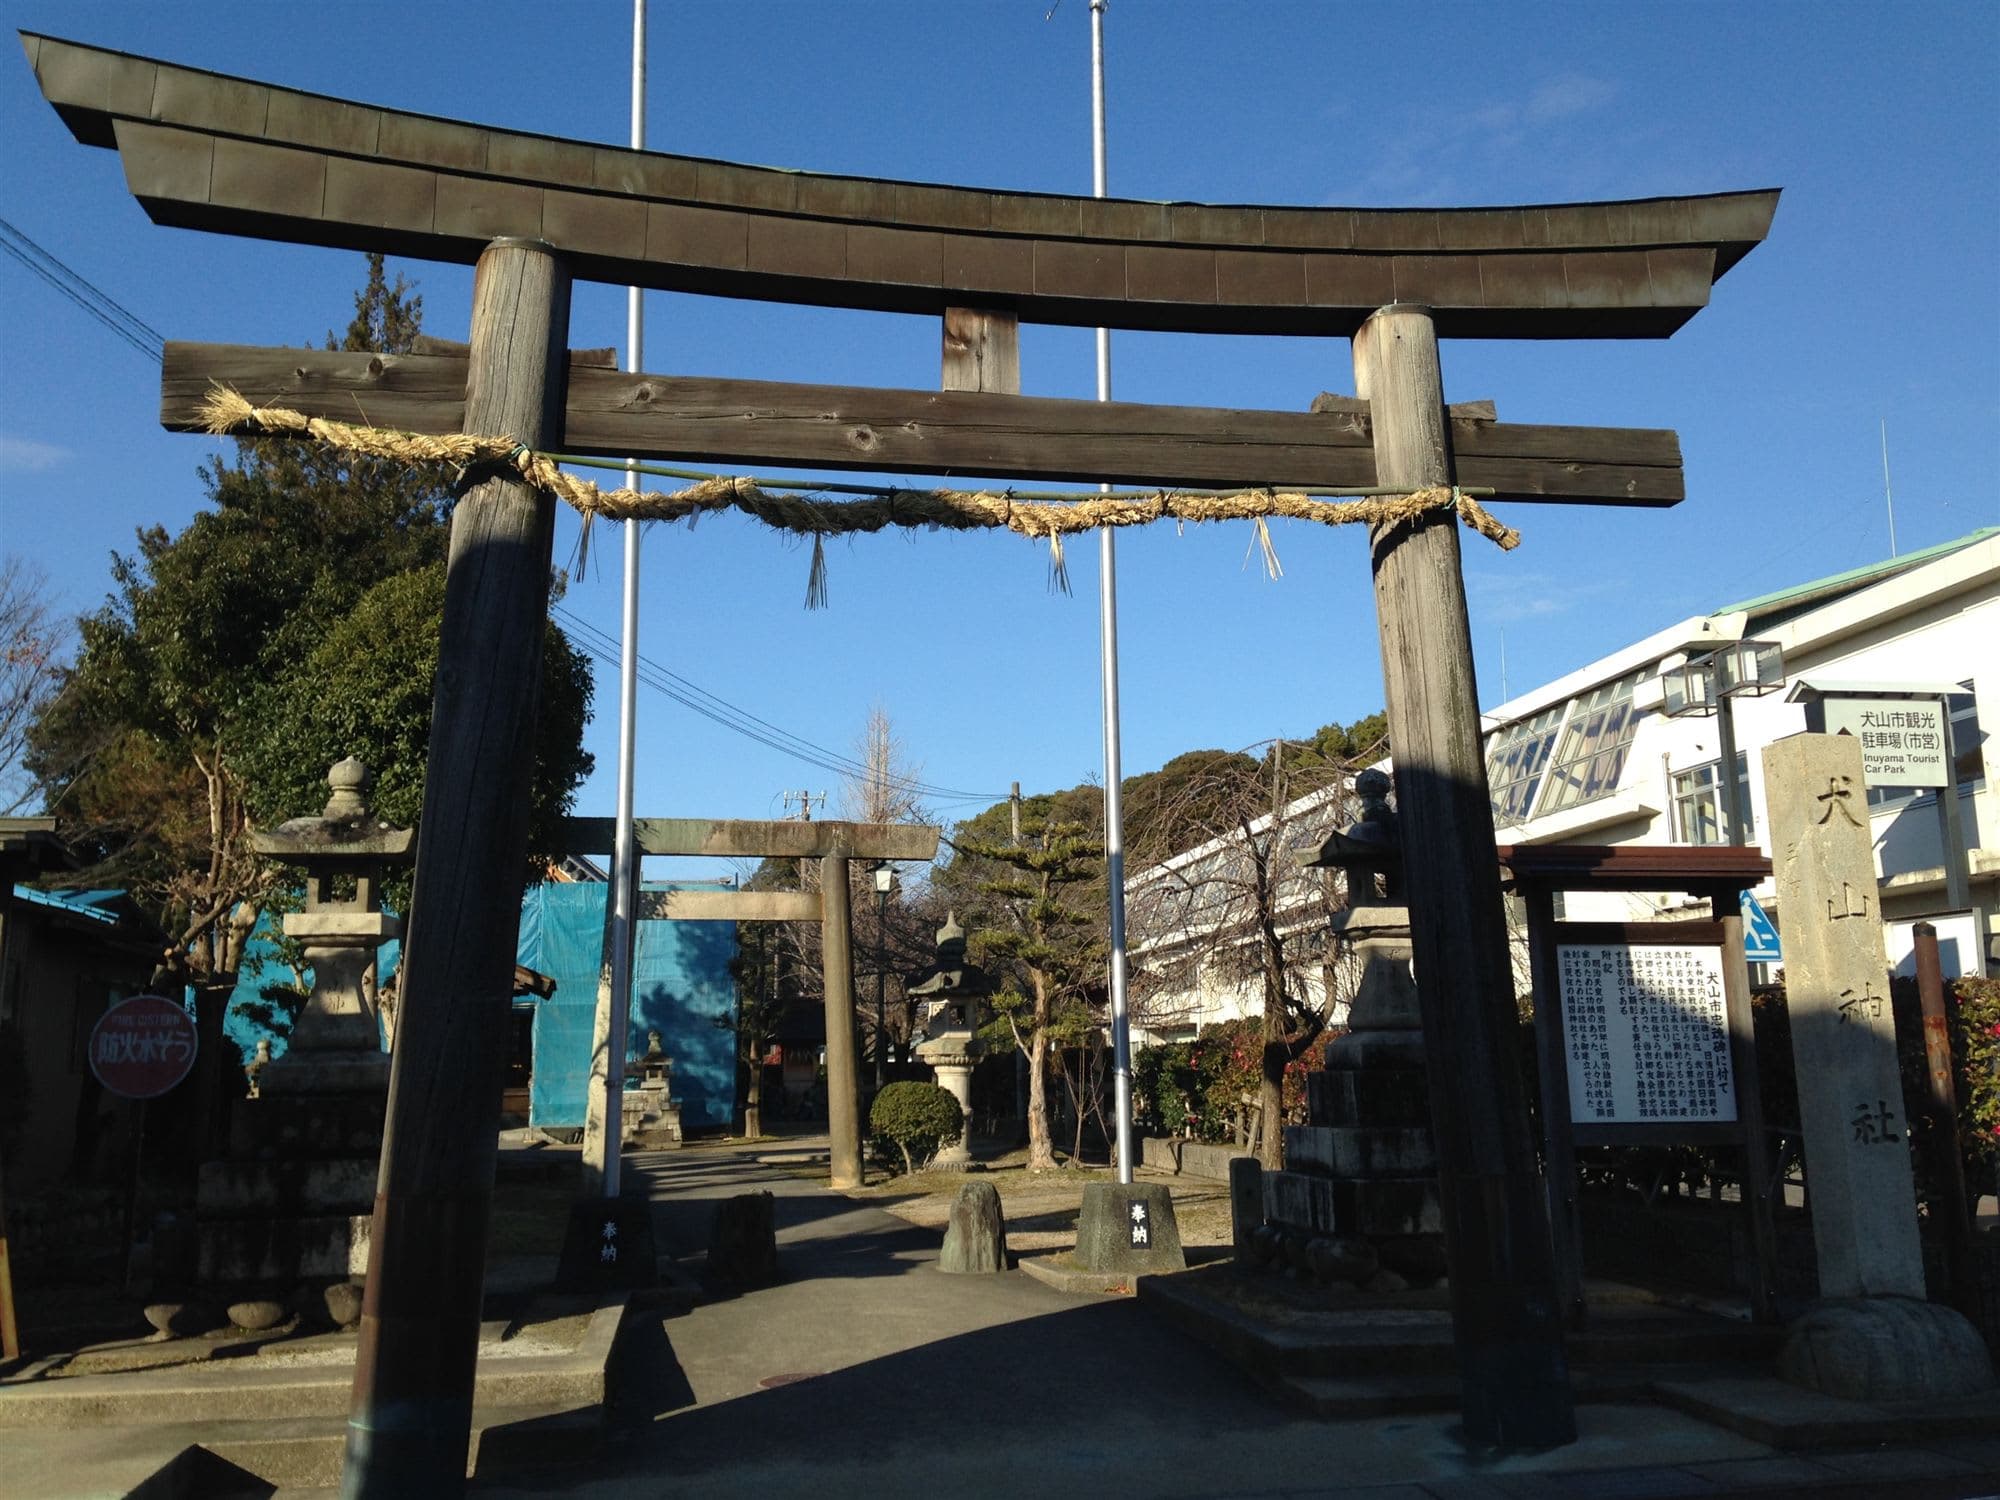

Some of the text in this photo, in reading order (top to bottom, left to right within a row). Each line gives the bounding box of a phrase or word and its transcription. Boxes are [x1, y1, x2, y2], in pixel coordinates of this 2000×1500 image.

[1860, 711, 1936, 729] 犬山市観光
[1864, 754, 1940, 764] Inuyama Tourist
[1864, 765, 1906, 774] Car Park
[1601, 951, 1612, 973] 附記
[97, 1030, 192, 1063] 防火水そう
[1131, 1204, 1148, 1243] 奉納
[601, 1221, 617, 1262] 奉納
